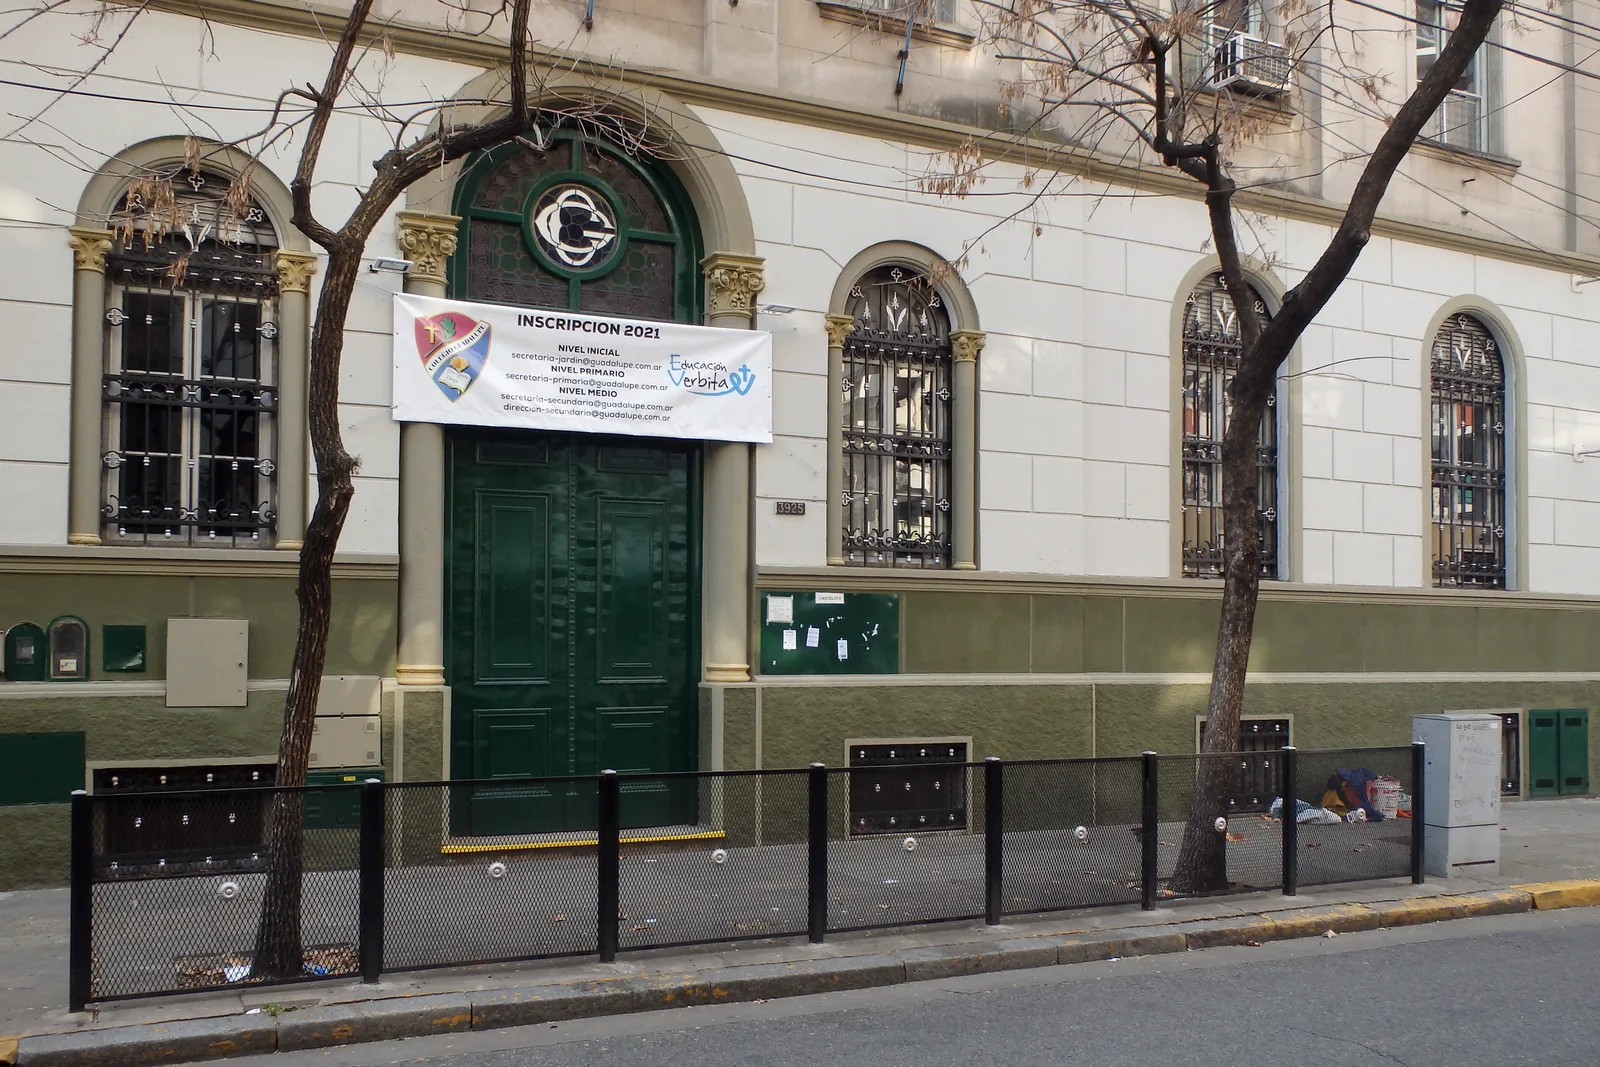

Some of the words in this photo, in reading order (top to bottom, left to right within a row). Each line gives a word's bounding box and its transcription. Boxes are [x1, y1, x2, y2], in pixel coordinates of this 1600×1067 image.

[517, 314, 620, 335] INSCRIPCION
[624, 324, 660, 339] 2021
[428, 347, 454, 371] COLEGIO
[558, 344, 585, 354] NIVEL
[587, 347, 620, 357] INICIAL
[511, 352, 662, 371] secretaria-jardin@guadalupe.com.ar
[669, 353, 727, 373] Educación
[551, 365, 578, 375] NIVEL
[580, 368, 625, 378] PRIMARIO
[667, 369, 729, 391] Verbita
[505, 372, 668, 391] secretaria-primaria@guadalupe.com.ar
[559, 386, 586, 396] NIVEL
[588, 388, 618, 398] MEDIO
[501, 392, 673, 412] secretaria-secundaria@guadalupe.com.ar
[777, 502, 804, 514] 3925
